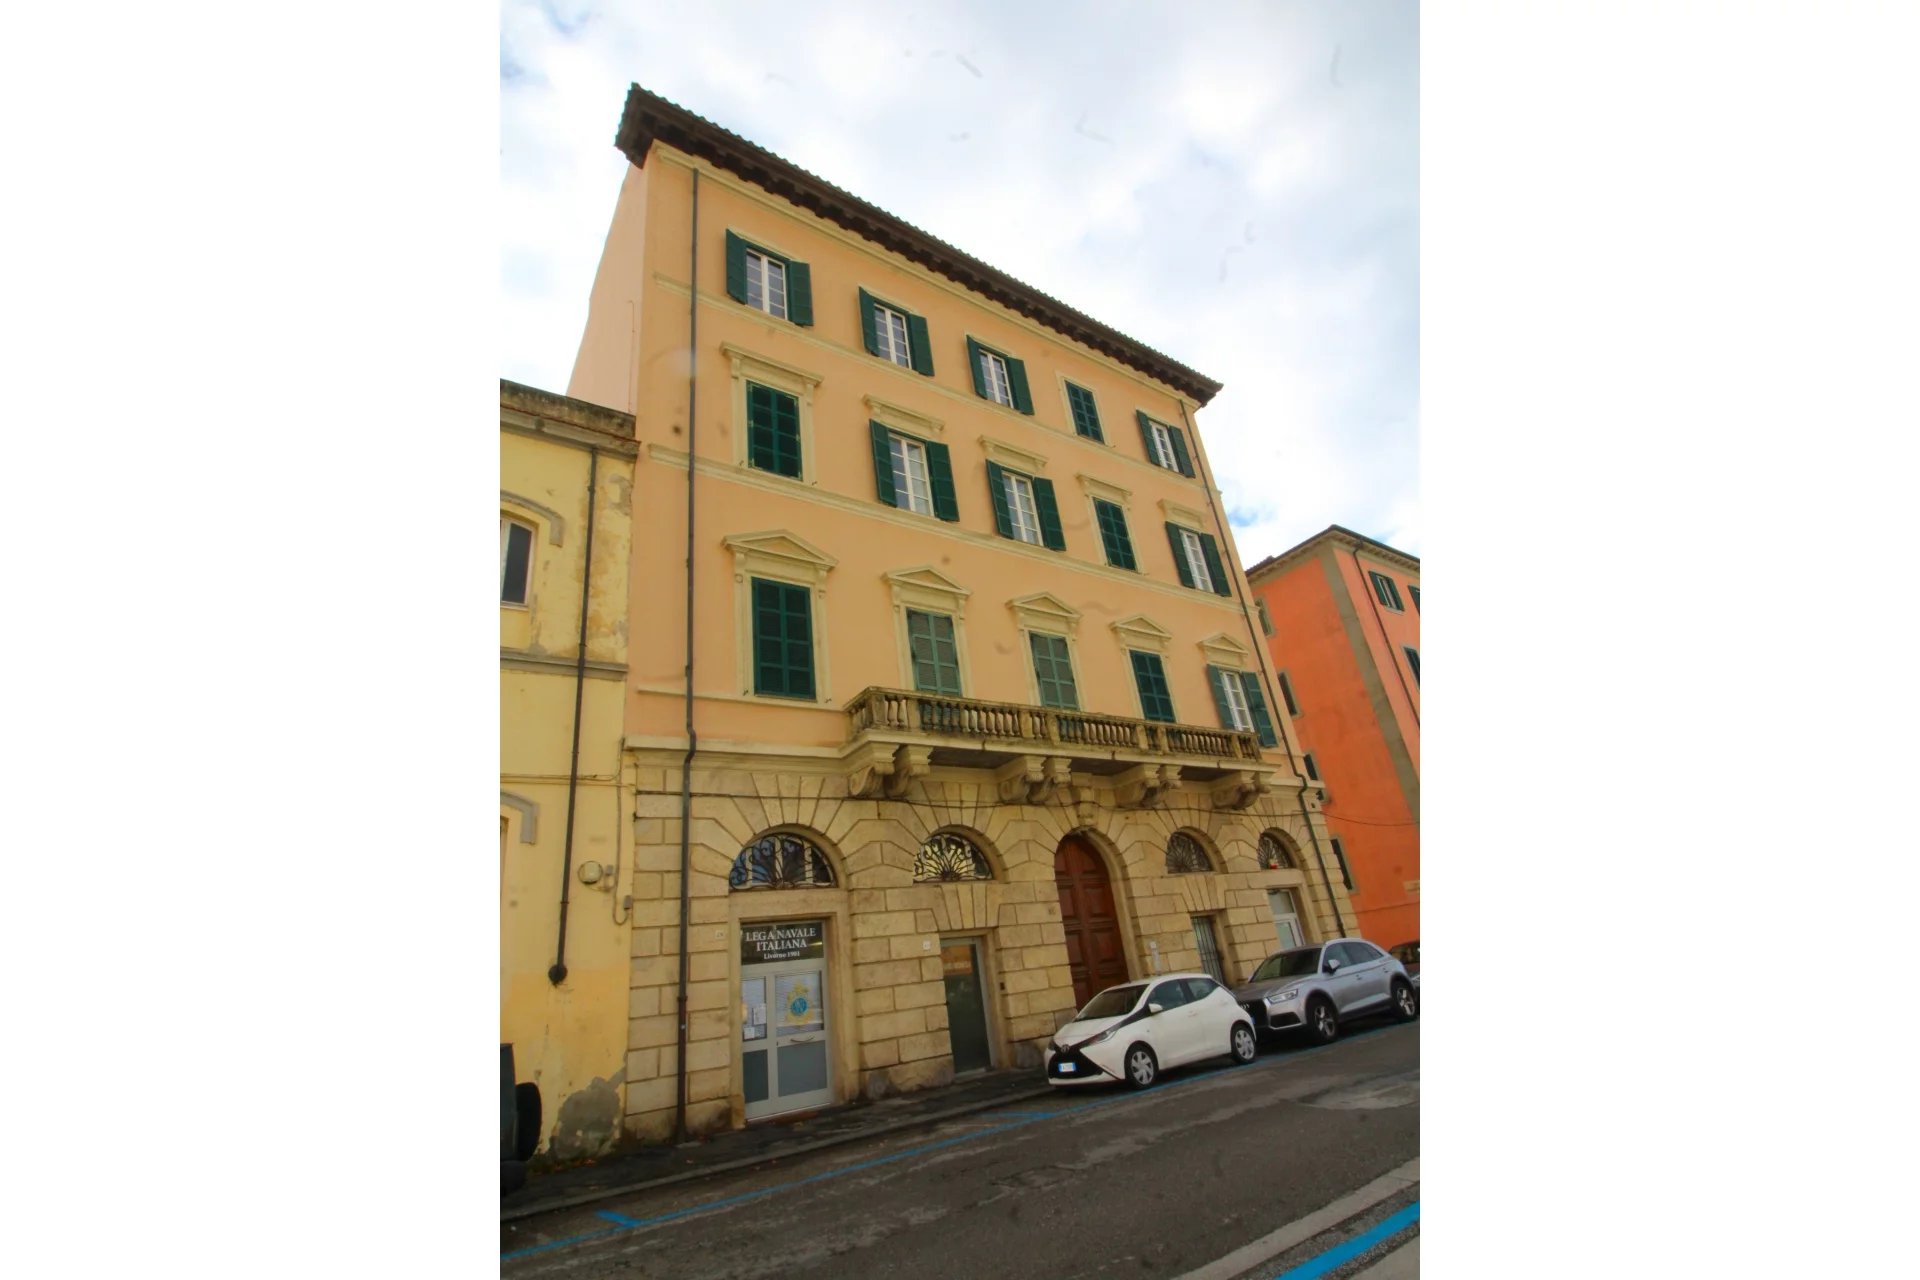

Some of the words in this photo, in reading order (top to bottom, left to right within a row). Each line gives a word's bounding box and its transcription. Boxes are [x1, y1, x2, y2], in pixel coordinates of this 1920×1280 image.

[746, 930, 775, 941] LEGA
[776, 928, 816, 939] NAVALE
[756, 939, 807, 951] ITALIANA
